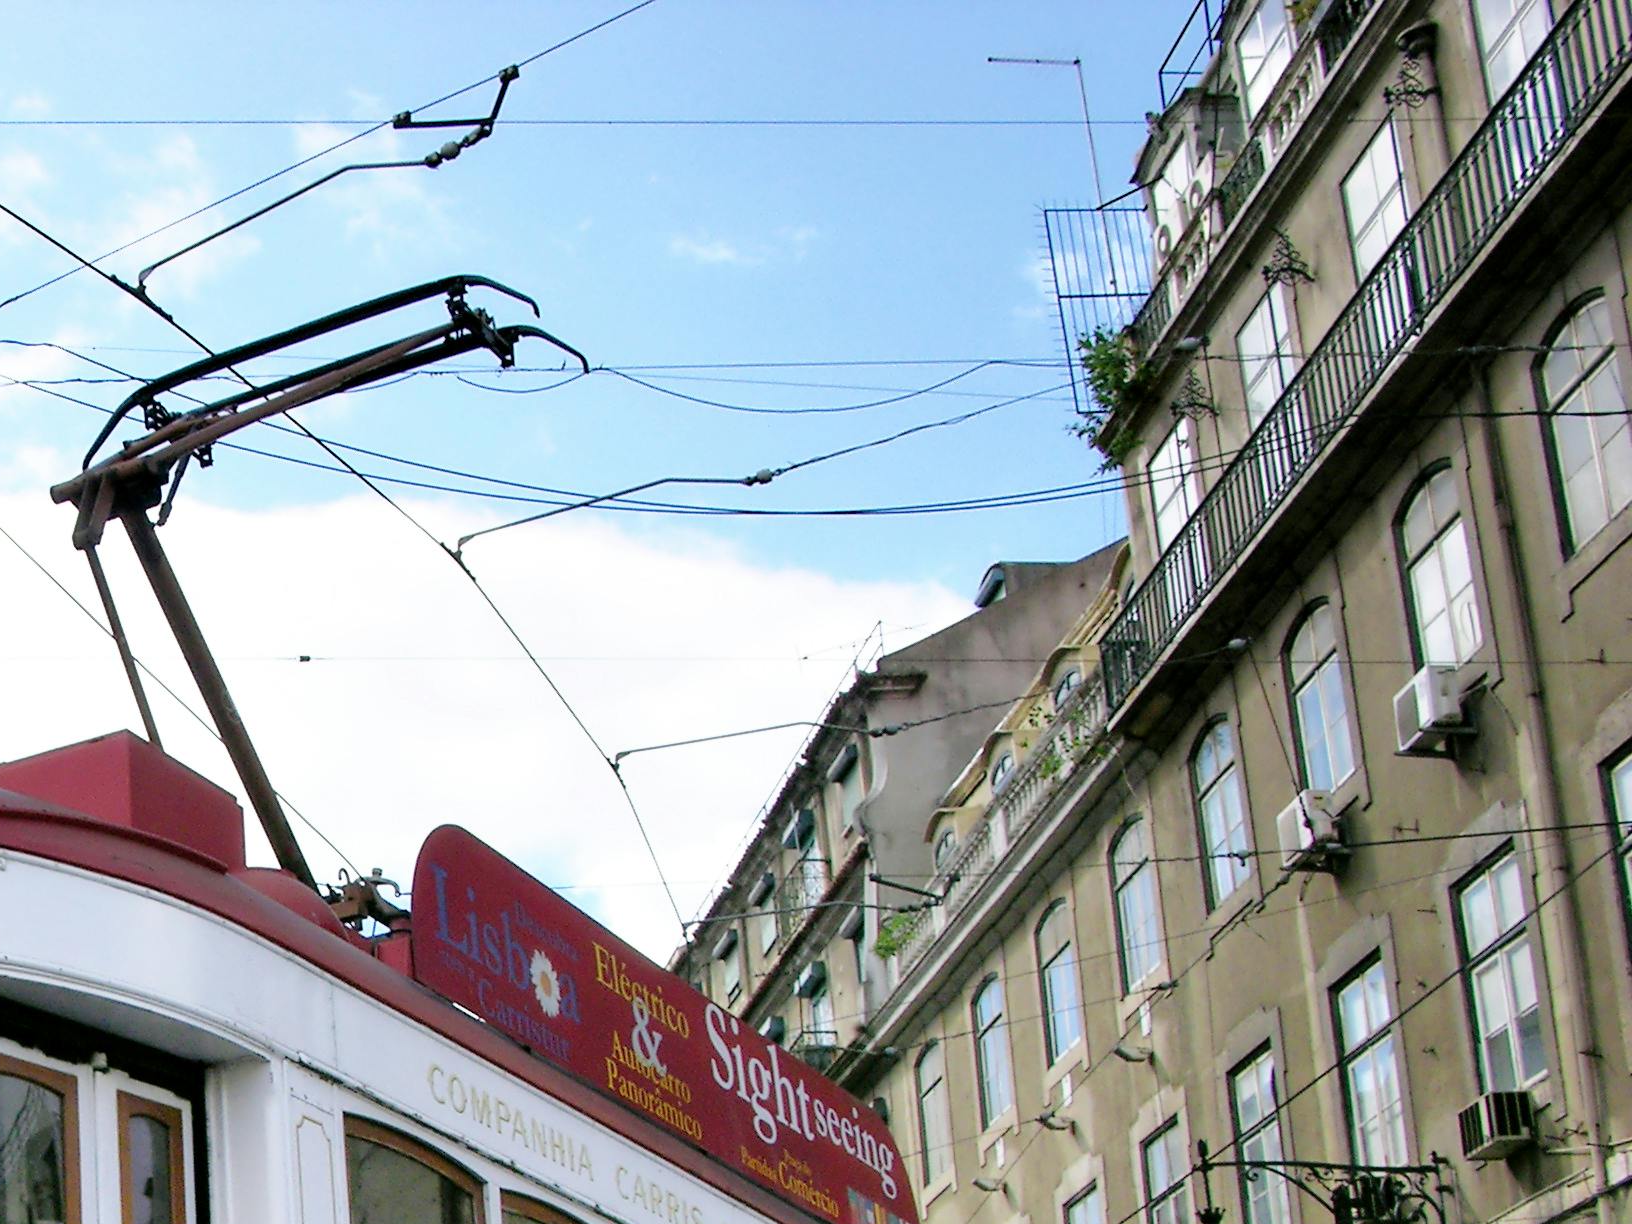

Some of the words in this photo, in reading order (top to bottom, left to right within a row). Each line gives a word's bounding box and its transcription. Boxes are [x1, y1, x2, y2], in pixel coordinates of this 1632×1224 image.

[592, 941, 691, 1040] Eléctrico
[631, 996, 668, 1077] &
[426, 1062, 594, 1183] COMPANHIA
[604, 1056, 703, 1141] Panorâmico
[704, 1002, 898, 1200] Sightseeing
